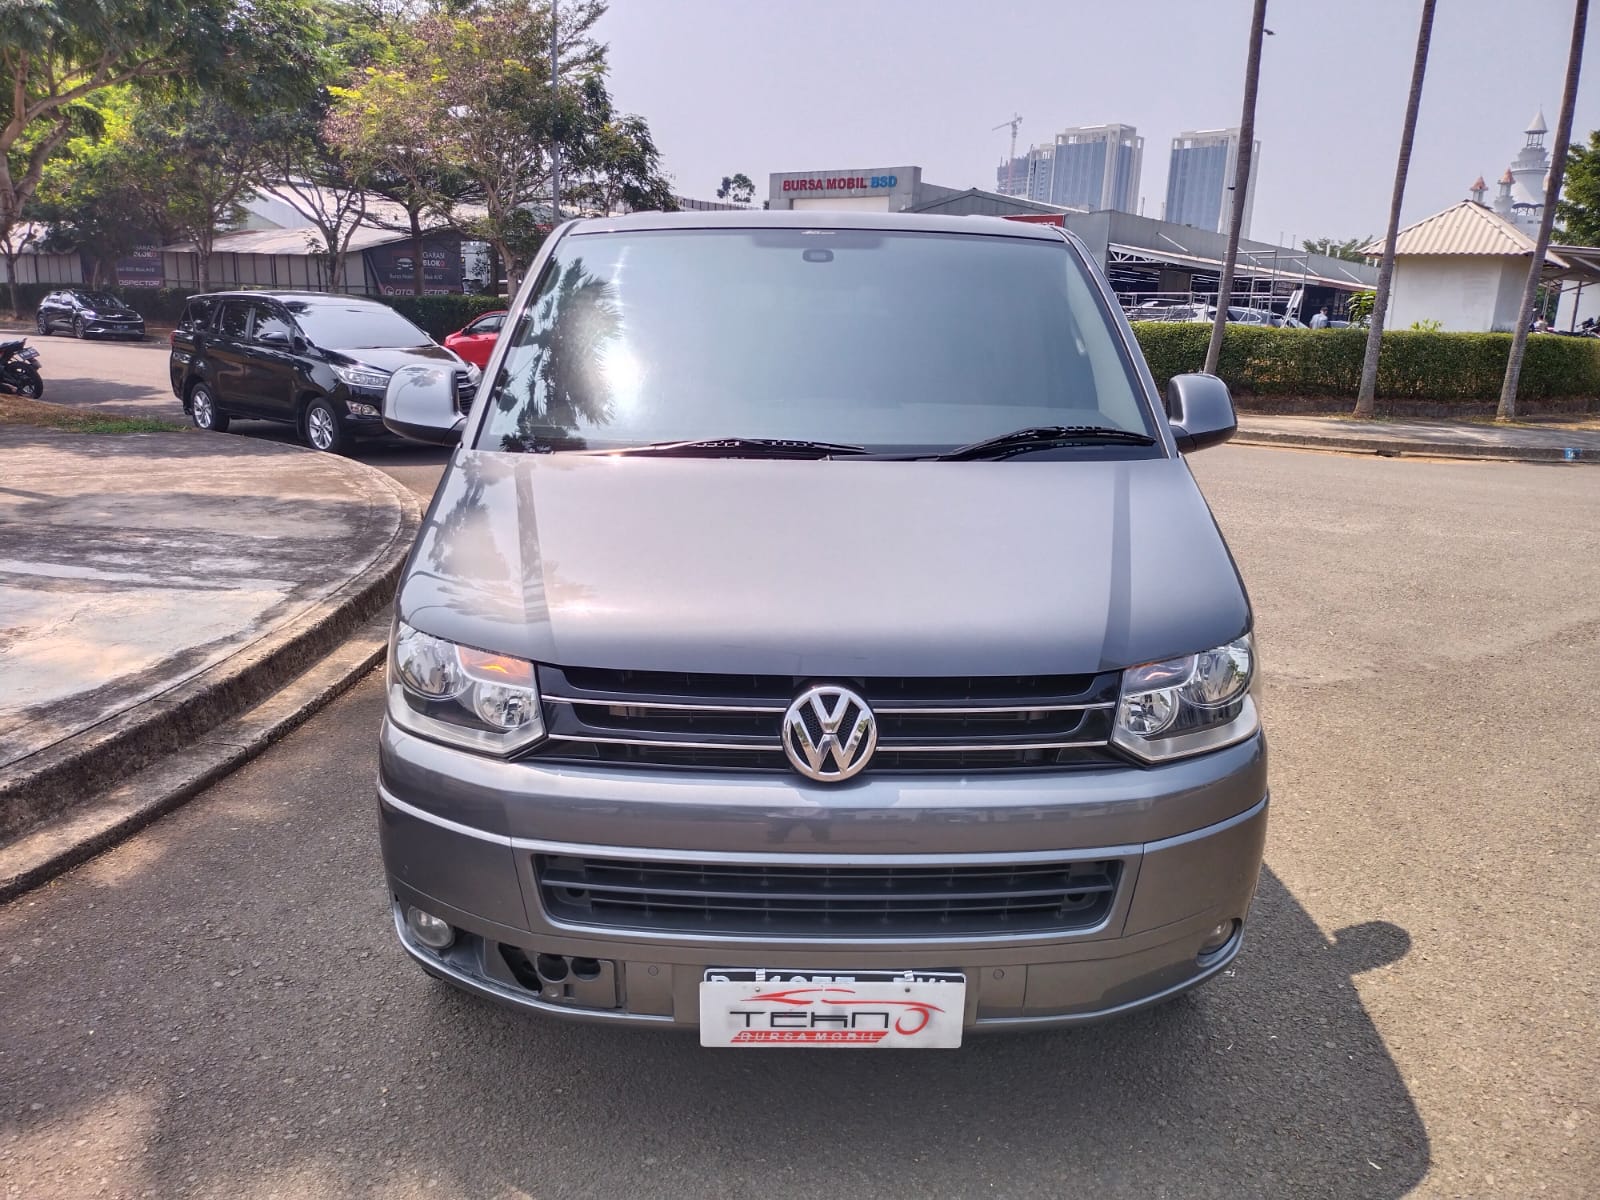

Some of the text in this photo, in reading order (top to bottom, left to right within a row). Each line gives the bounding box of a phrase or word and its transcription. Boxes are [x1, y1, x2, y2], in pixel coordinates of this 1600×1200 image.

[783, 176, 897, 191] BURSA MOBIL BSD
